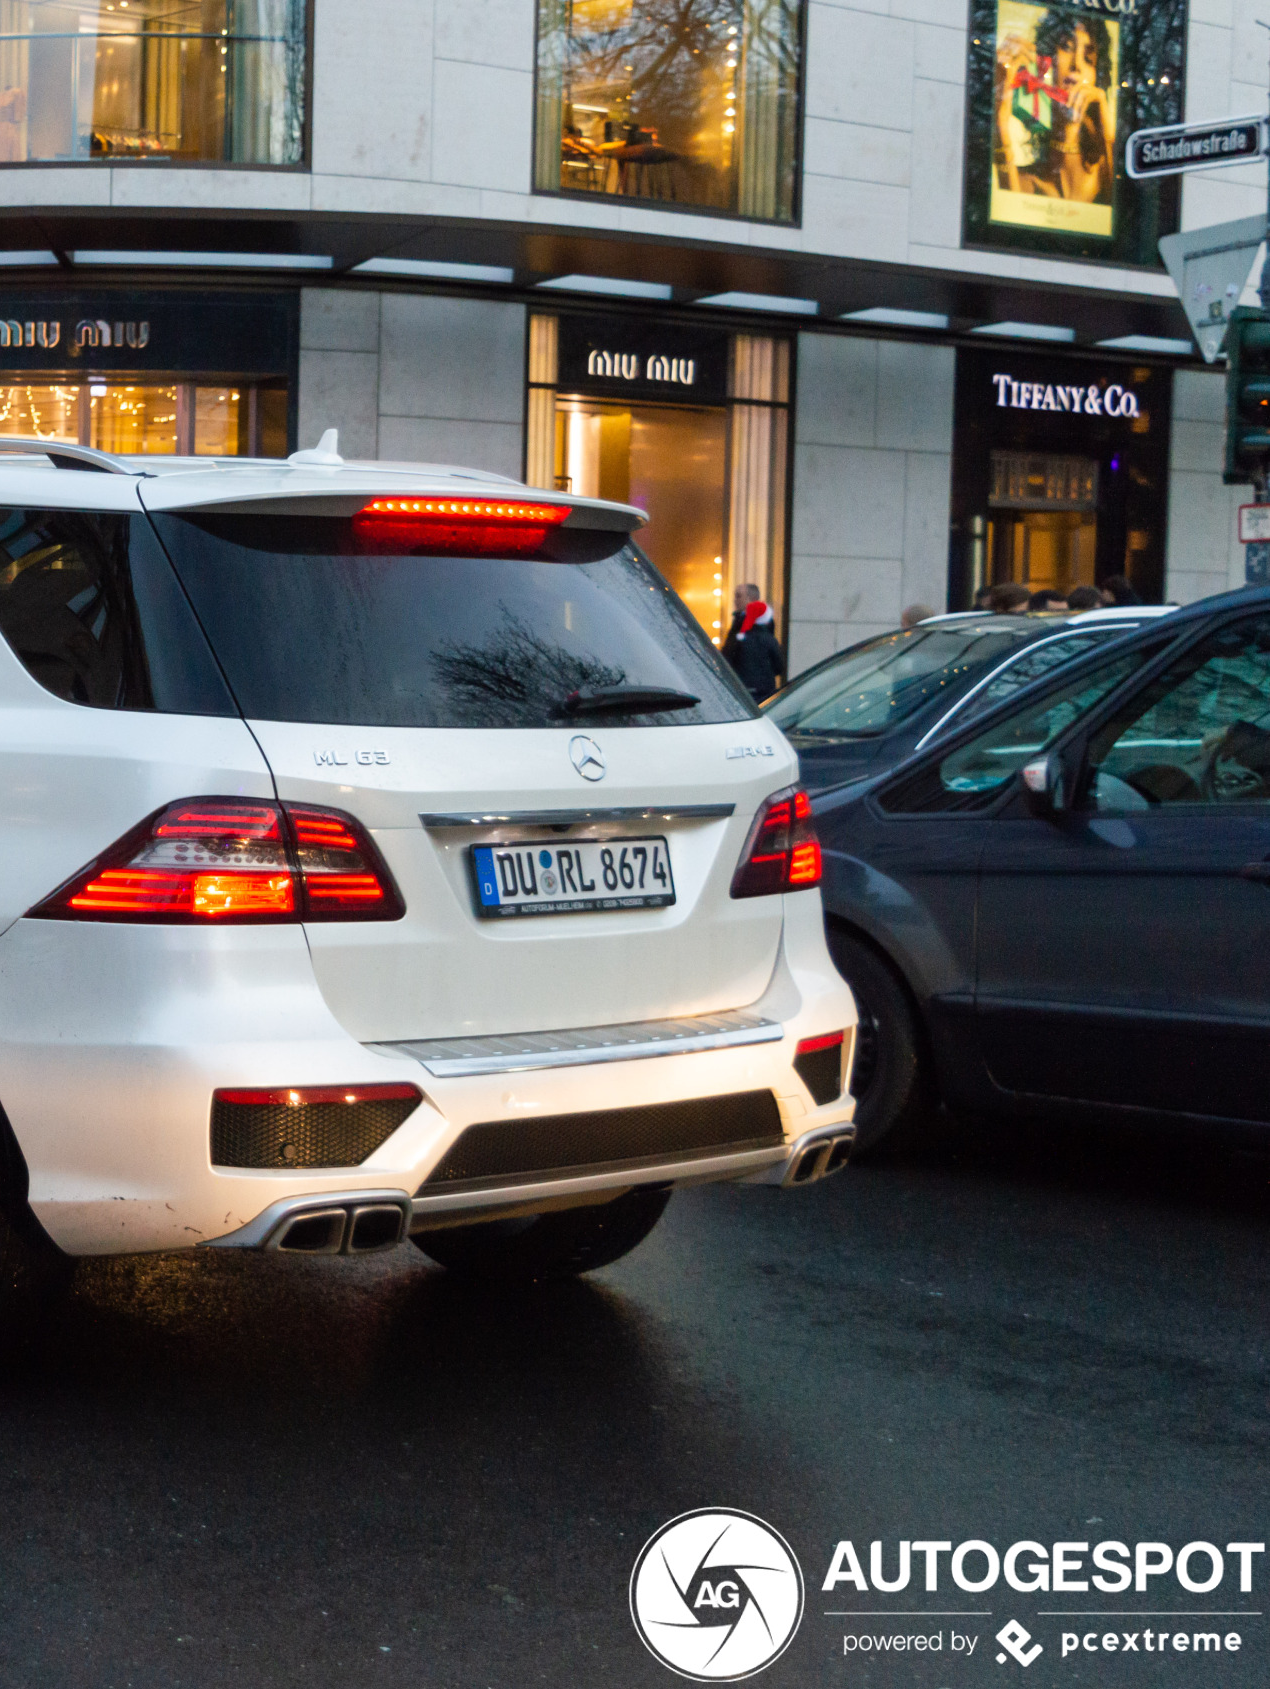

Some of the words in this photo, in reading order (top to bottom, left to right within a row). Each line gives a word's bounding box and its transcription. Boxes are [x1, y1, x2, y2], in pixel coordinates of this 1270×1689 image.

[1142, 129, 1247, 163] Schadowstraße
[313, 750, 348, 766] ML
[355, 749, 391, 766] 63
[496, 851, 538, 897] DU
[556, 849, 595, 893] RL
[600, 846, 667, 891] 8674
[484, 882, 493, 895] D
